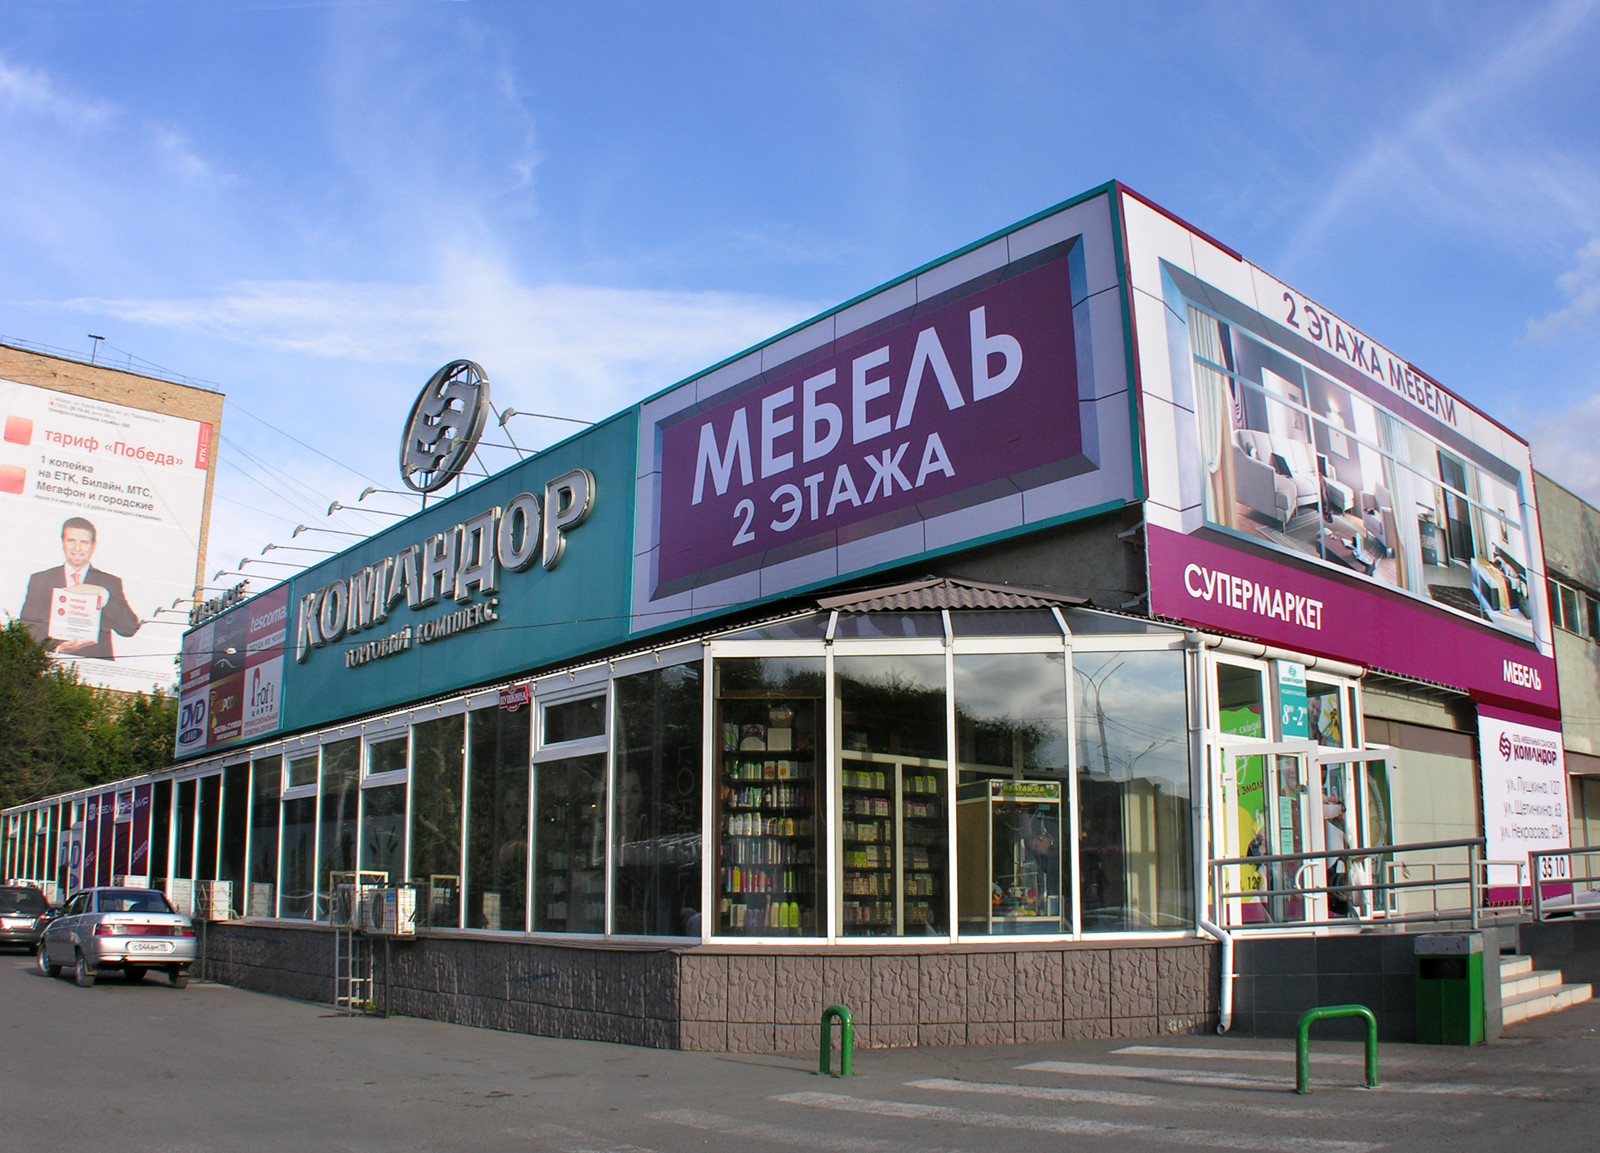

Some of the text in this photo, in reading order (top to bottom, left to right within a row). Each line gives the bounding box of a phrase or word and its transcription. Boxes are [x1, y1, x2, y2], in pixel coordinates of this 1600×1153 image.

[1283, 292, 1457, 427] 2 ЭТАЖА МЕБЕЛИ
[691, 305, 1023, 506] МЕБЕЛЬ
[41, 456, 94, 473] 1 копейка
[45, 430, 184, 466] тариф «Победа»
[38, 470, 51, 479] на
[732, 431, 956, 547] 2 ЭТАЖА
[36, 481, 86, 498] Мегафон
[89, 492, 96, 500] и
[98, 494, 155, 511] городские
[296, 468, 597, 665] КОМАНДОР
[1184, 563, 1323, 630] СУПЕРМАРКЕТ
[345, 597, 499, 669] ТОРГОВЫЙ КОМПЛЕКС
[1503, 659, 1542, 691] МЕБЕЛЬ
[181, 699, 206, 730] DVD
[1513, 744, 1557, 766] КОМАНДОР
[1549, 780, 1560, 795] 127
